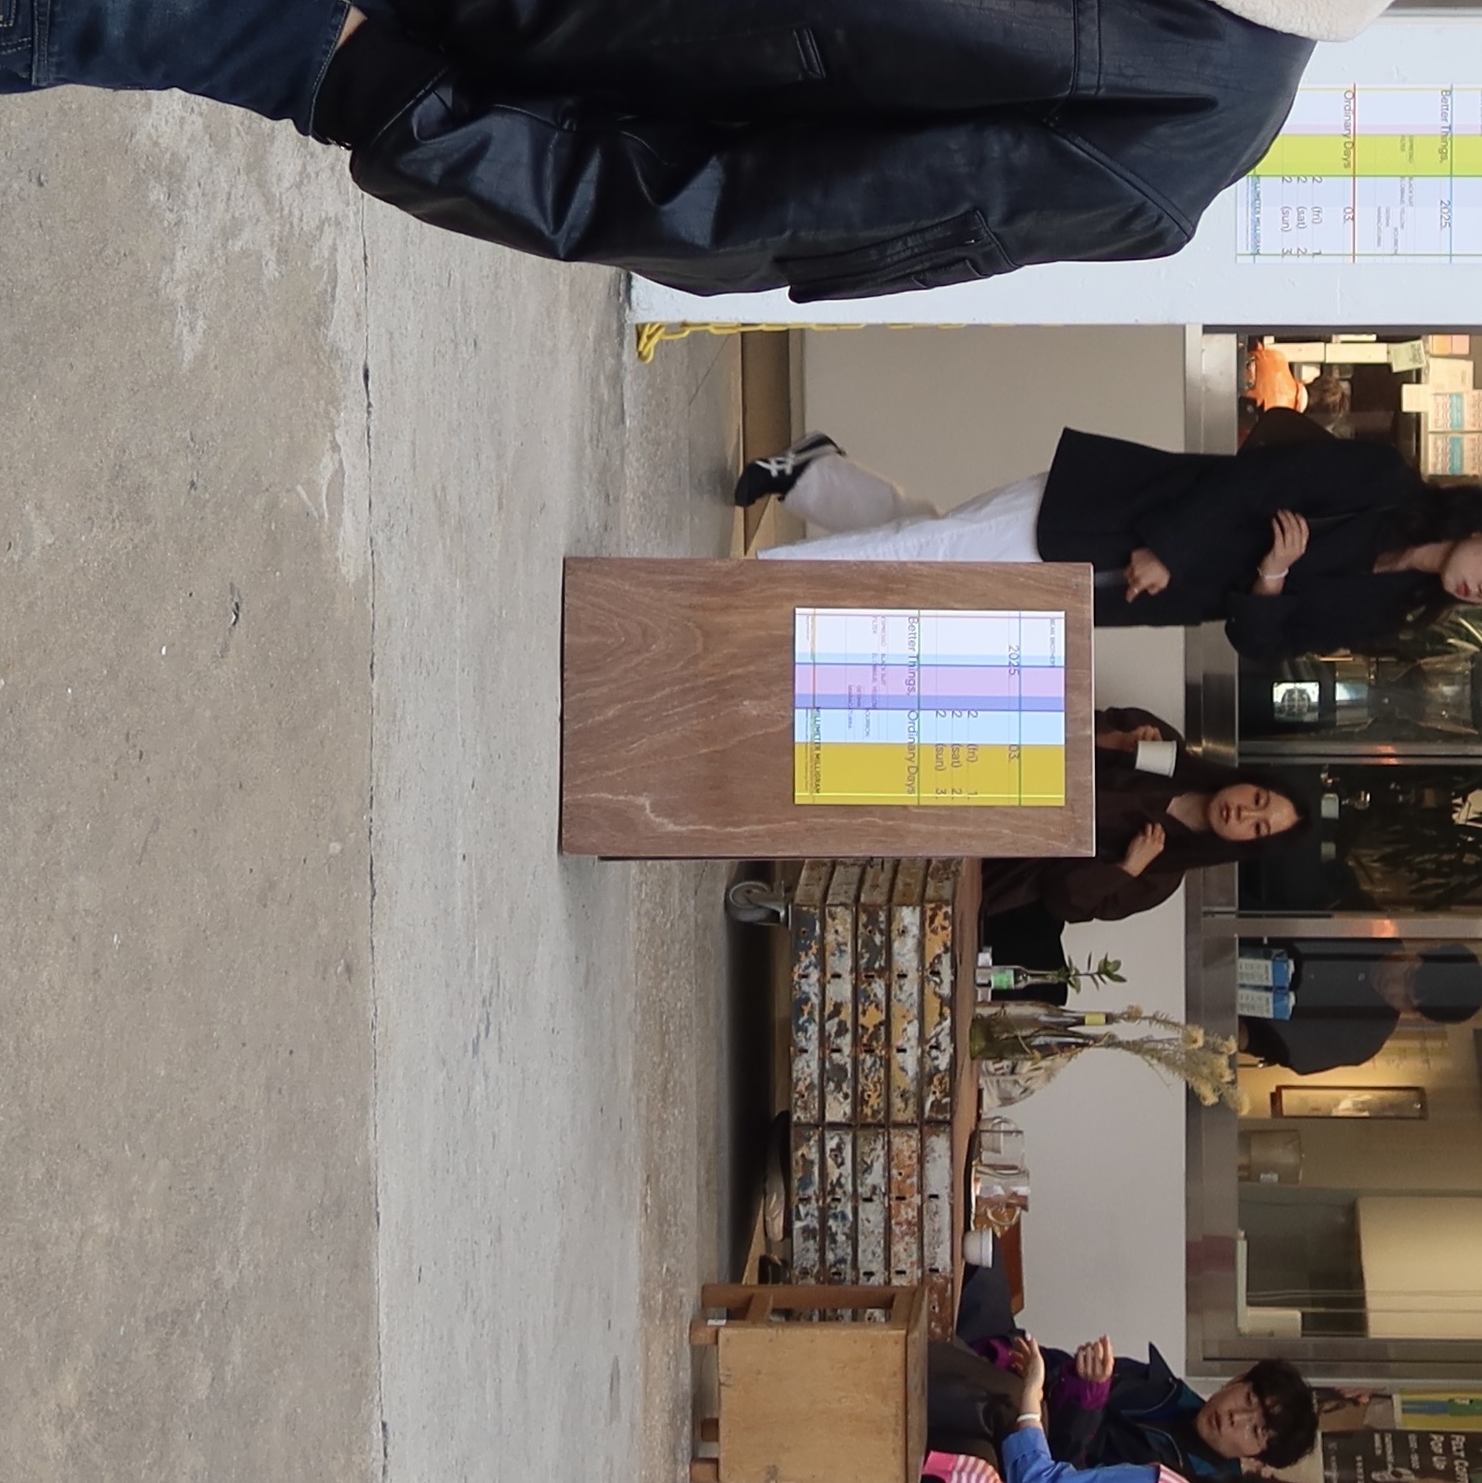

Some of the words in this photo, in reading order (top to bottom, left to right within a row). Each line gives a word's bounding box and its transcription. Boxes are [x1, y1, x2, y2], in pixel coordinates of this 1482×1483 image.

[1341, 90, 1354, 138] Ordinary
[1440, 90, 1451, 122] Better
[1341, 141, 1353, 169] Days
[1438, 125, 1451, 164] Things,
[1280, 206, 1292, 232] (sun)
[1295, 206, 1307, 229] (sat)
[1310, 206, 1322, 225] (fri)
[1439, 200, 1451, 231] 2025.
[907, 617, 918, 651] Better
[905, 654, 918, 696] Things,
[905, 710, 918, 762] Ordinary
[934, 743, 946, 772] (sun)
[950, 743, 962, 768] (sat)
[966, 743, 978, 763] (fri)
[905, 765, 918, 795] Days
[1429, 1433, 1445, 1454] POP
[1451, 1434, 1466, 1458] FELT
[1432, 1456, 1447, 1471] UP
